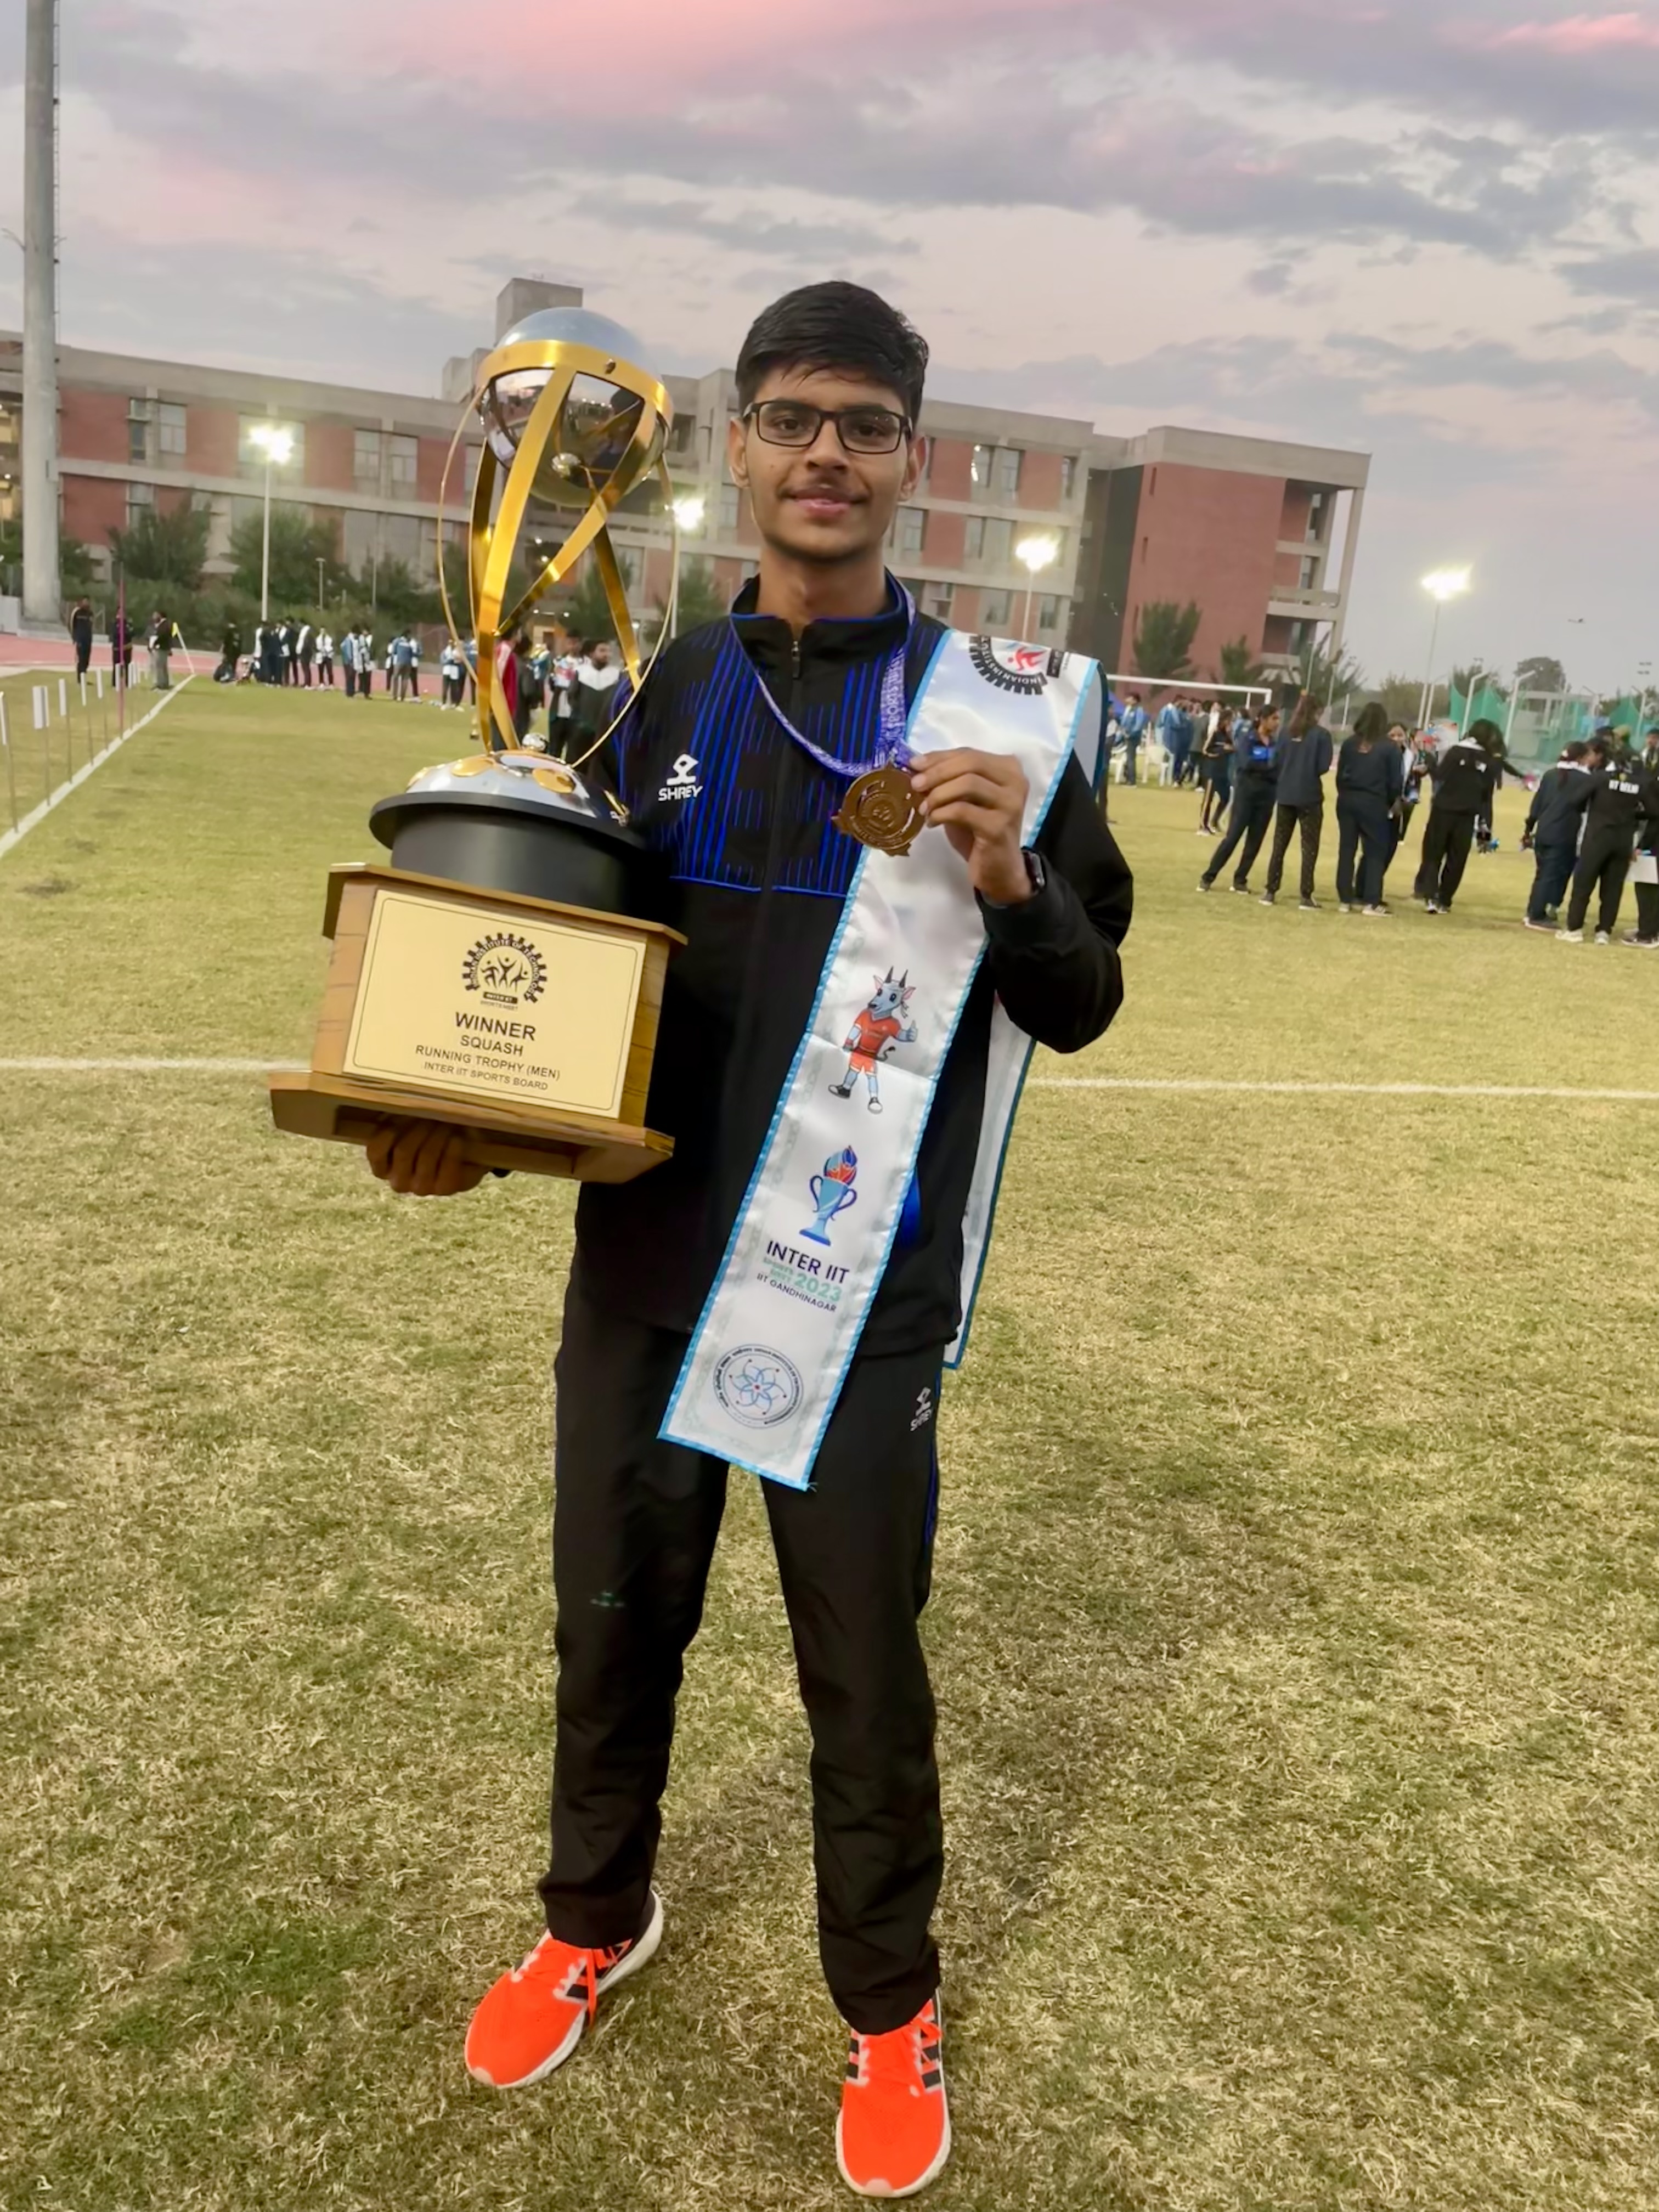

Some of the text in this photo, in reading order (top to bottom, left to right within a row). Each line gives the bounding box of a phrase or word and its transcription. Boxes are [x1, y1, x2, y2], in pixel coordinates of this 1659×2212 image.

[1003, 673, 1042, 685] INDIAN
[658, 785, 703, 801] SHREY
[455, 1012, 536, 1041] WINNER
[460, 1035, 523, 1057] SQUASH
[415, 1045, 560, 1081] RUNNING TROPHY (MEN)
[424, 1062, 548, 1091] INTER IIT SPORTS BOARD
[766, 1240, 850, 1284] INTER IIT
[757, 1273, 837, 1312] IIT GANDHINAGAR
[794, 1273, 843, 1302] 2023
